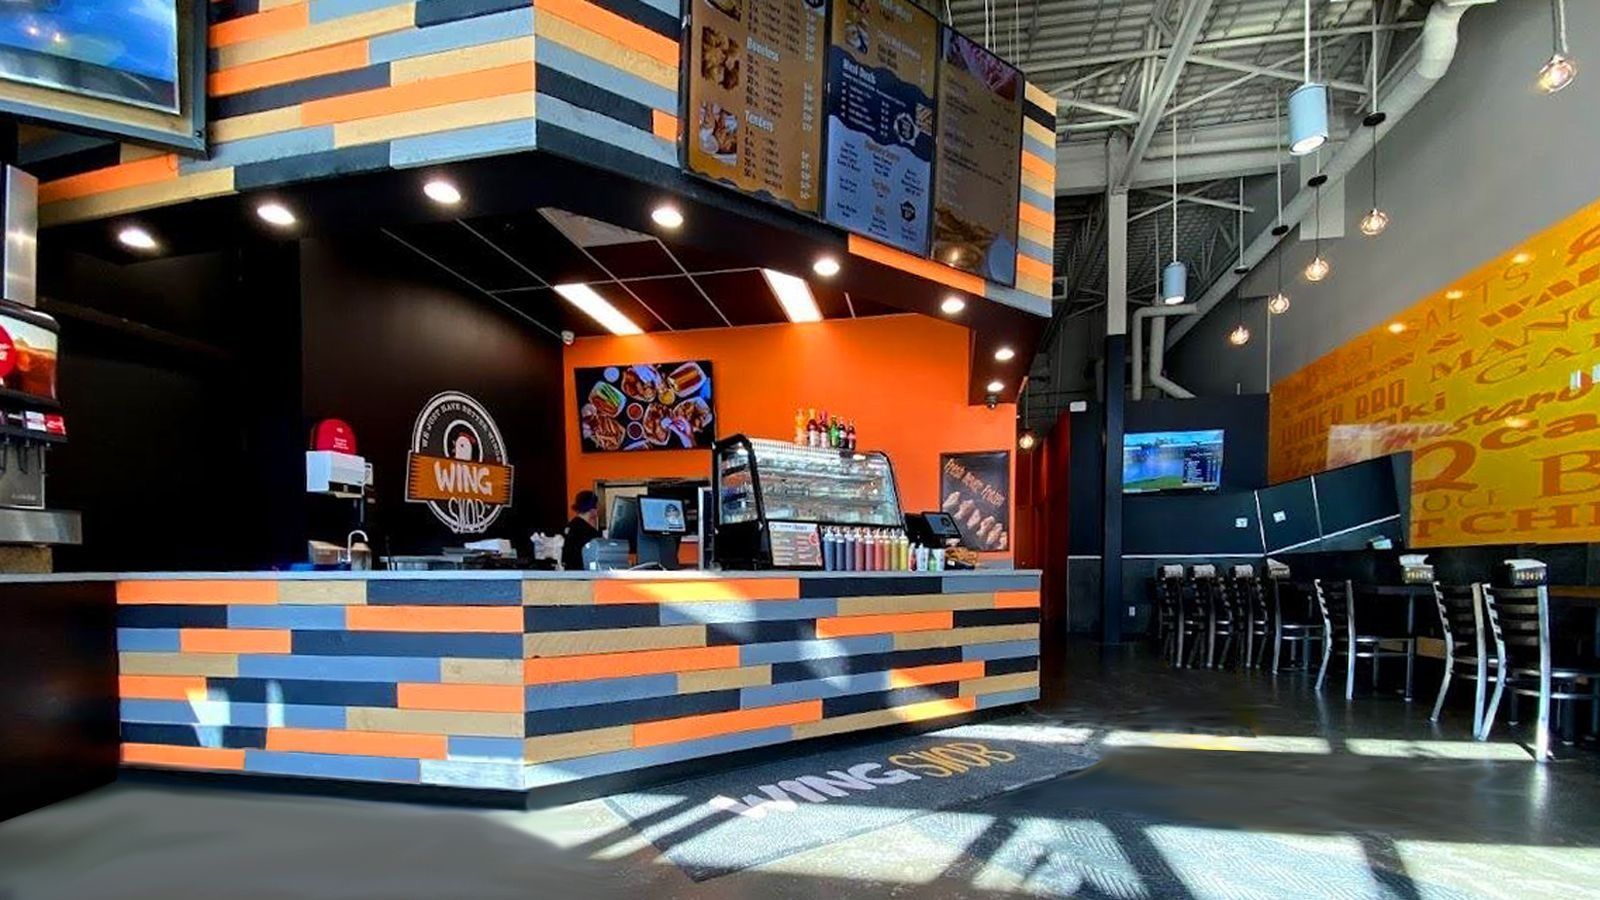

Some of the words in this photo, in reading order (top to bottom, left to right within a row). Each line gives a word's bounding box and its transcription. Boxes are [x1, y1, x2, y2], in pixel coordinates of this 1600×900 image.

[427, 409, 441, 430] JUST
[440, 403, 460, 414] HAVE
[462, 405, 488, 432] BETTER
[1355, 379, 1405, 420] BBQ
[434, 461, 493, 496] WING
[708, 762, 922, 818] WING
